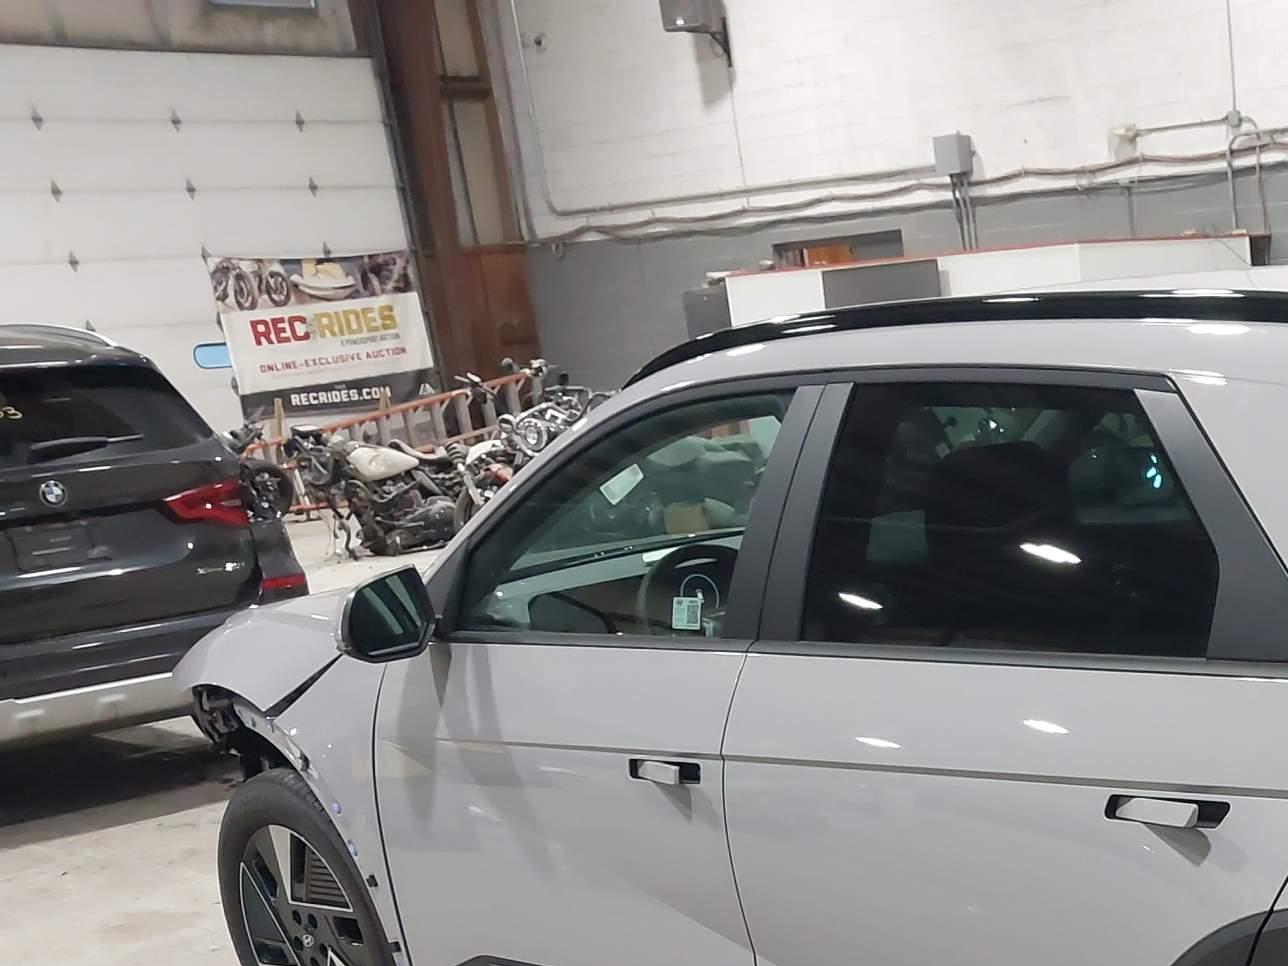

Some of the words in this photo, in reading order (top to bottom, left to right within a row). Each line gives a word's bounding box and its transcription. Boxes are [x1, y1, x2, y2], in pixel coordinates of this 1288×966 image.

[250, 315, 311, 346] REC
[314, 304, 398, 338] RIDES
[259, 352, 362, 373] ONLINE-EXCLUSIVE
[366, 346, 407, 360] AUCTION
